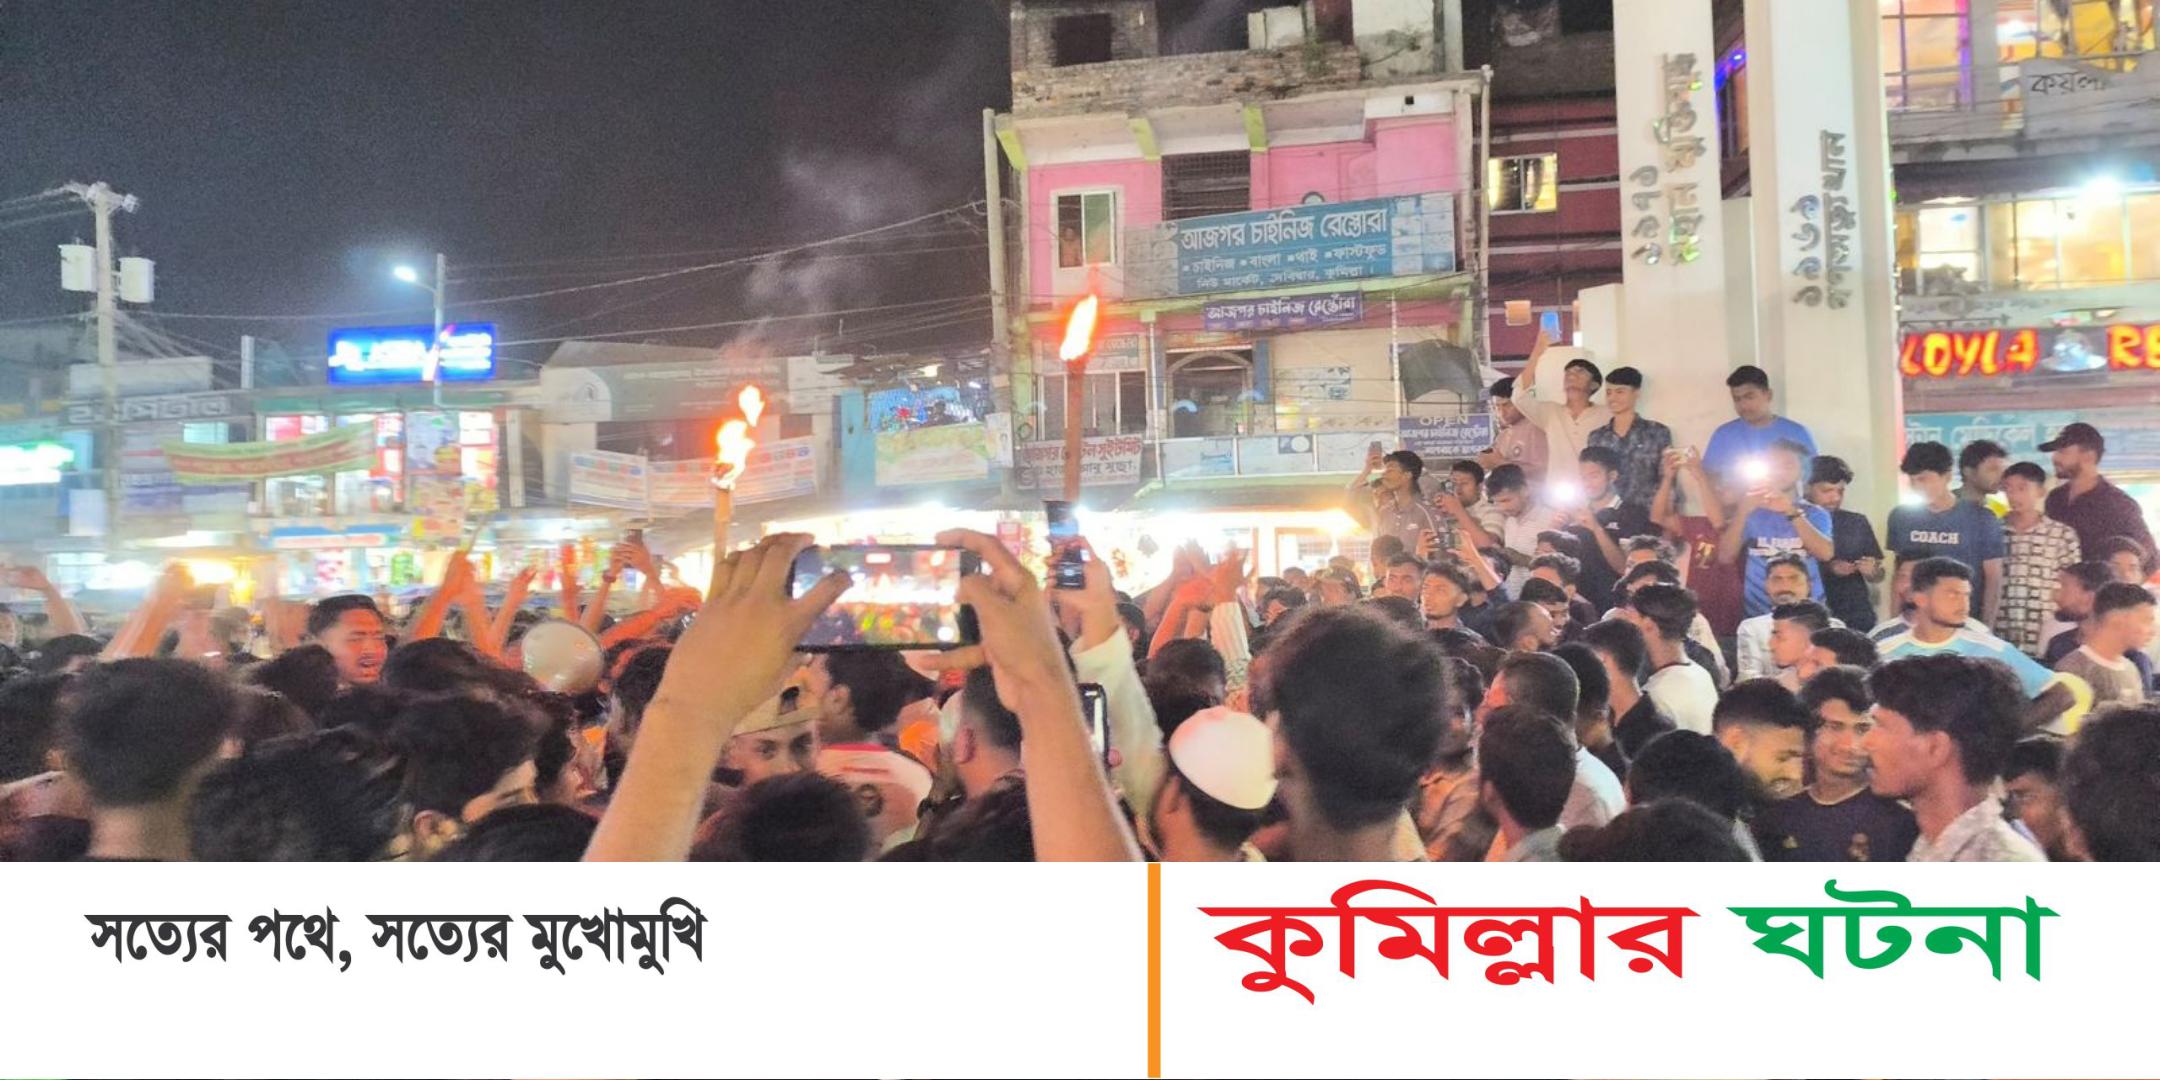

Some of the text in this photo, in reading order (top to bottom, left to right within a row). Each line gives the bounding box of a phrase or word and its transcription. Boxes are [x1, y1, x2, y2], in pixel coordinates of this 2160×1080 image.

[1629, 164, 1662, 265] ১৯৭১
[1180, 222, 1245, 251] আজগর
[1251, 209, 1315, 245] চাইনিজ
[1790, 194, 1823, 308] ১৯৬৯
[1257, 297, 1305, 316] চাইনিজ
[1420, 413, 1469, 426] OPEN
[1911, 530, 1959, 544] COACH
